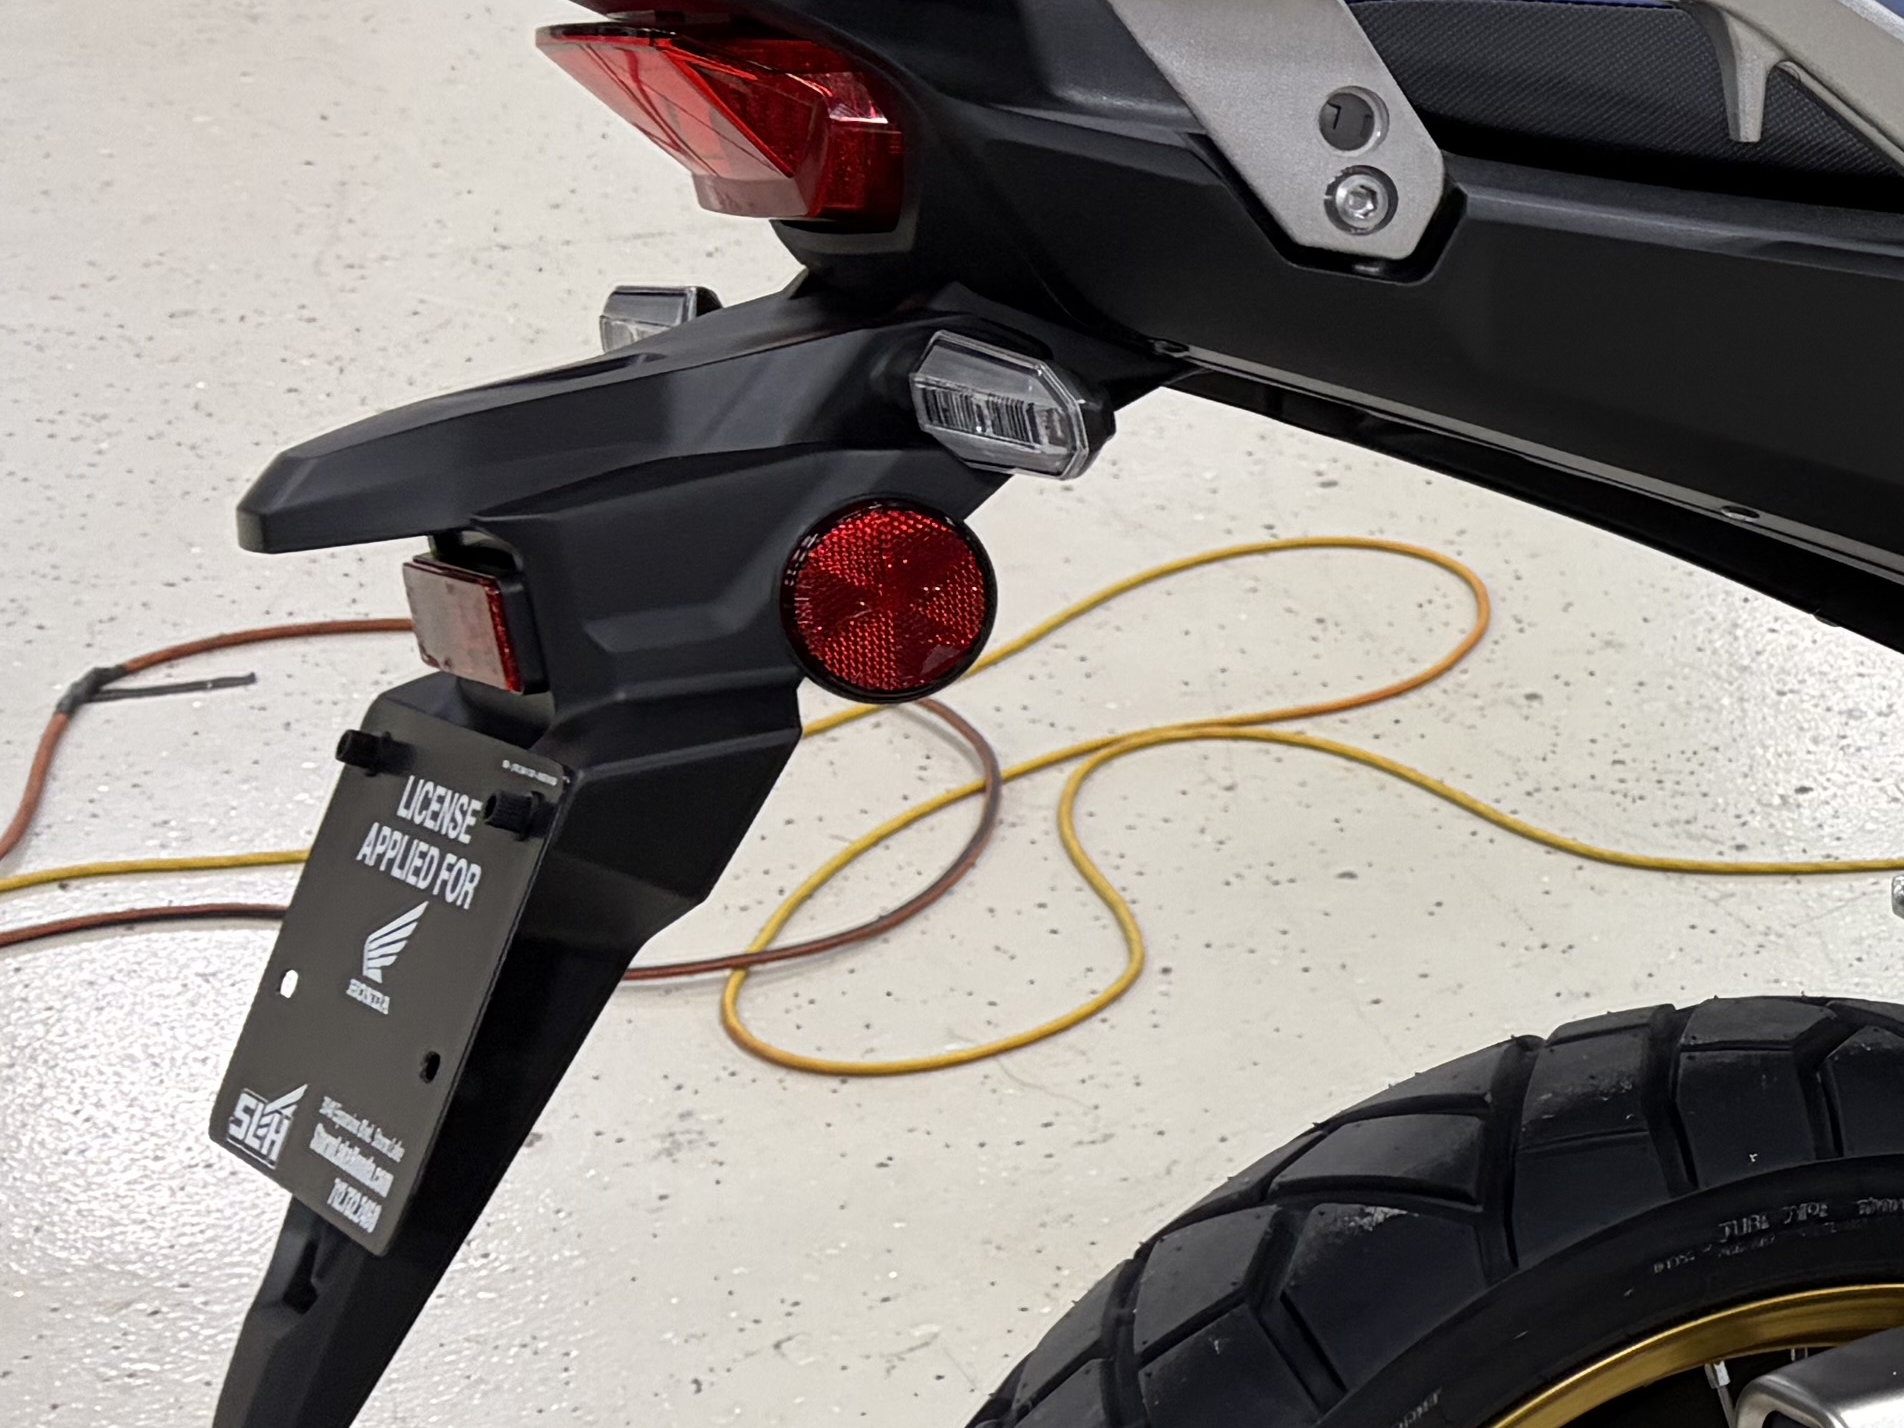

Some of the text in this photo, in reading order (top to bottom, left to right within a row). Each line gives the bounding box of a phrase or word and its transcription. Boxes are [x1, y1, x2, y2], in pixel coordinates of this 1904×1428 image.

[396, 775, 482, 844] LICENSE
[356, 822, 481, 910] APPLIED FOR
[346, 978, 390, 1015] HONDA
